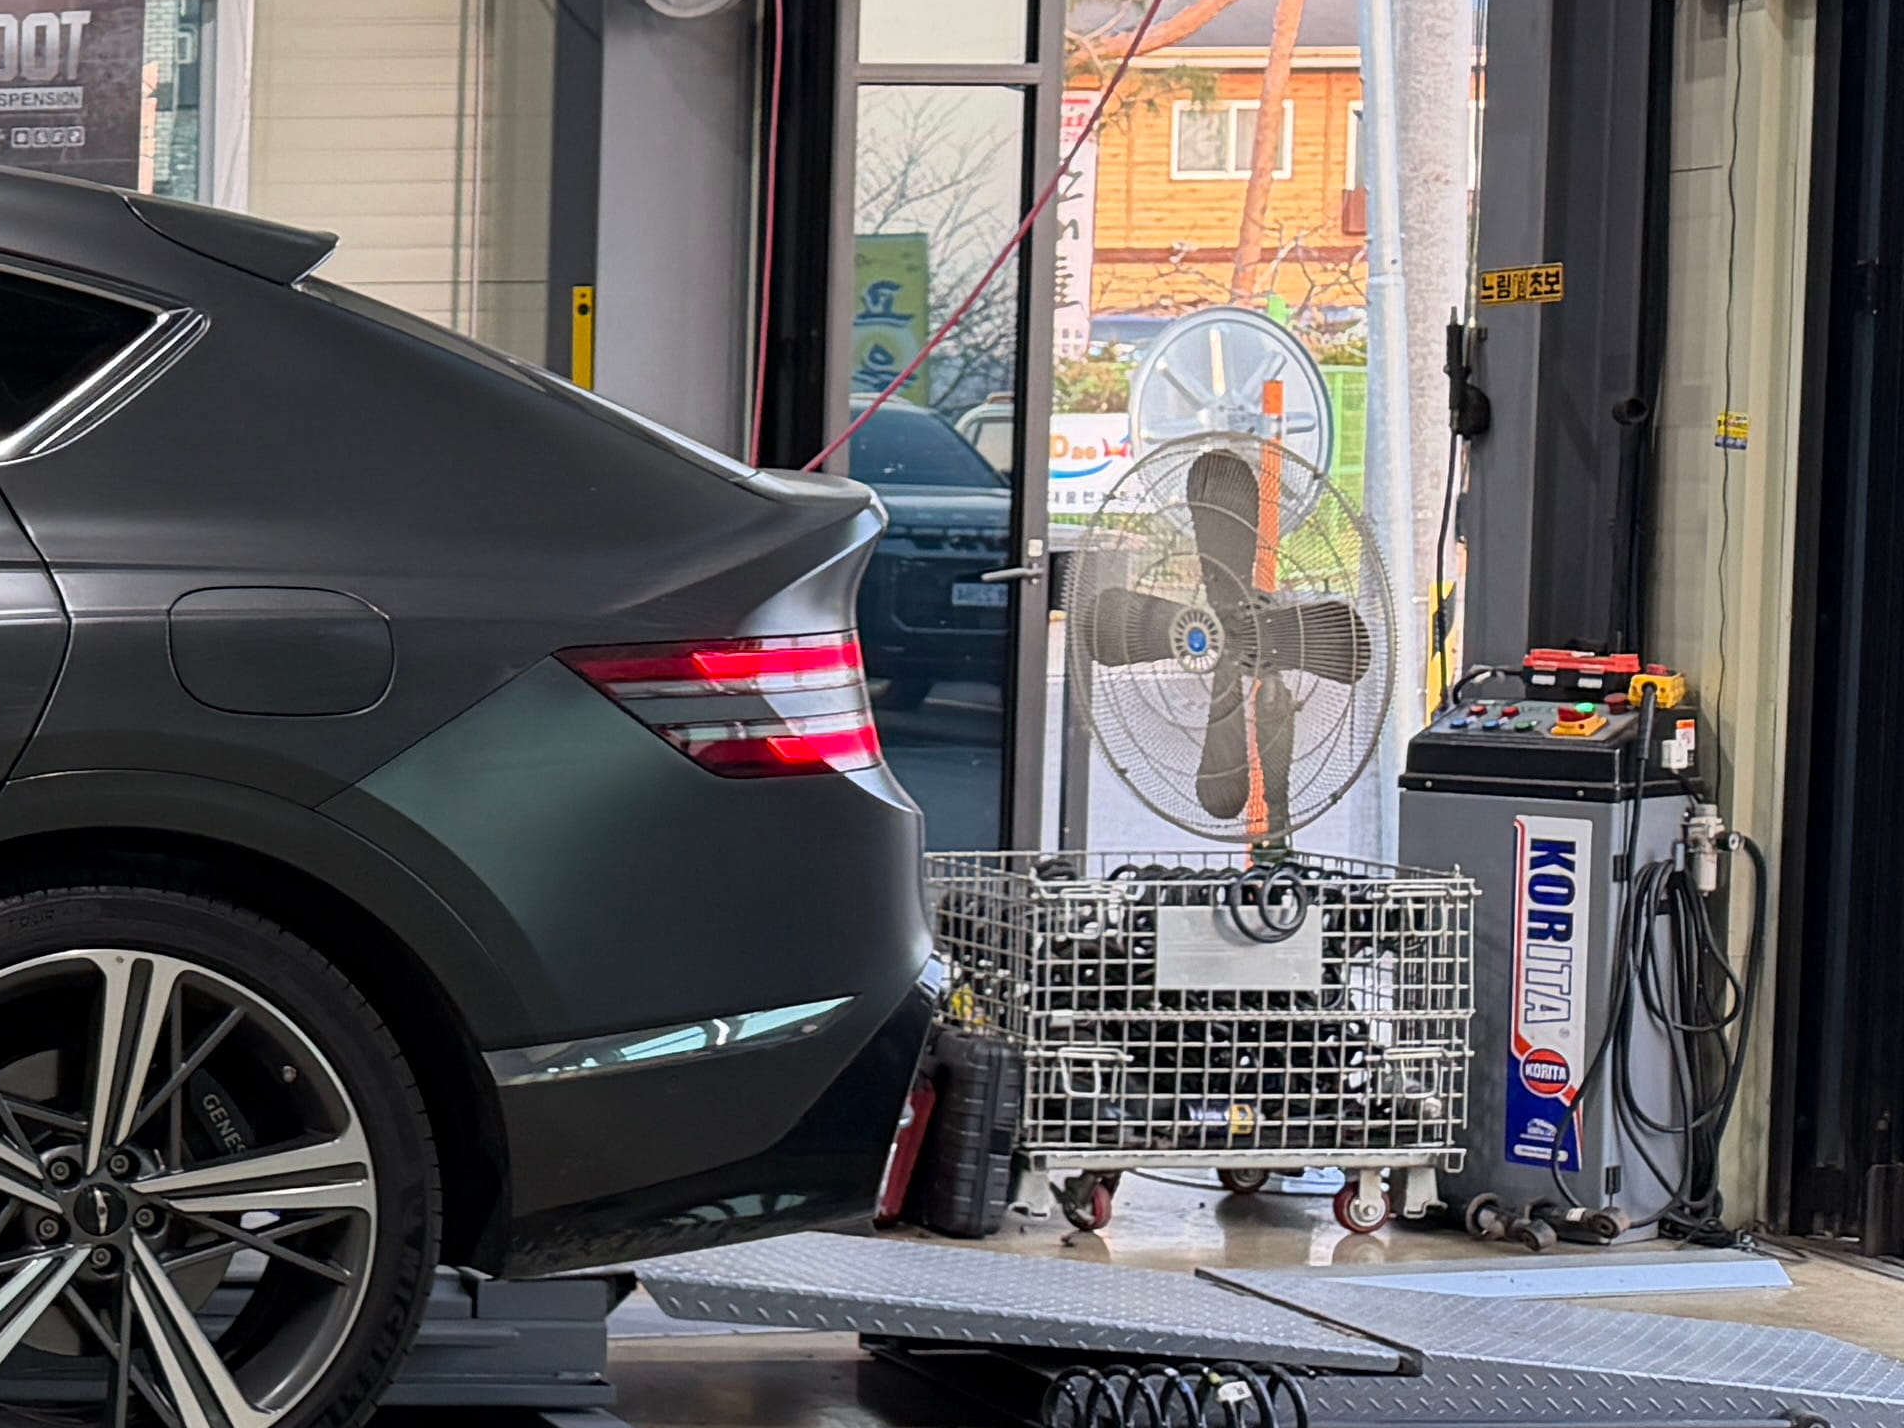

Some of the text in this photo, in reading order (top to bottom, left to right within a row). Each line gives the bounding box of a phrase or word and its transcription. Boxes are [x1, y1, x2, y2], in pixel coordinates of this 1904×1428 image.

[1481, 274, 1511, 300] 느림
[1529, 270, 1561, 297] 초보
[1525, 837, 1577, 1024] KORITA
[1525, 1062, 1567, 1082] KORITA
[201, 1092, 247, 1155] GENES
